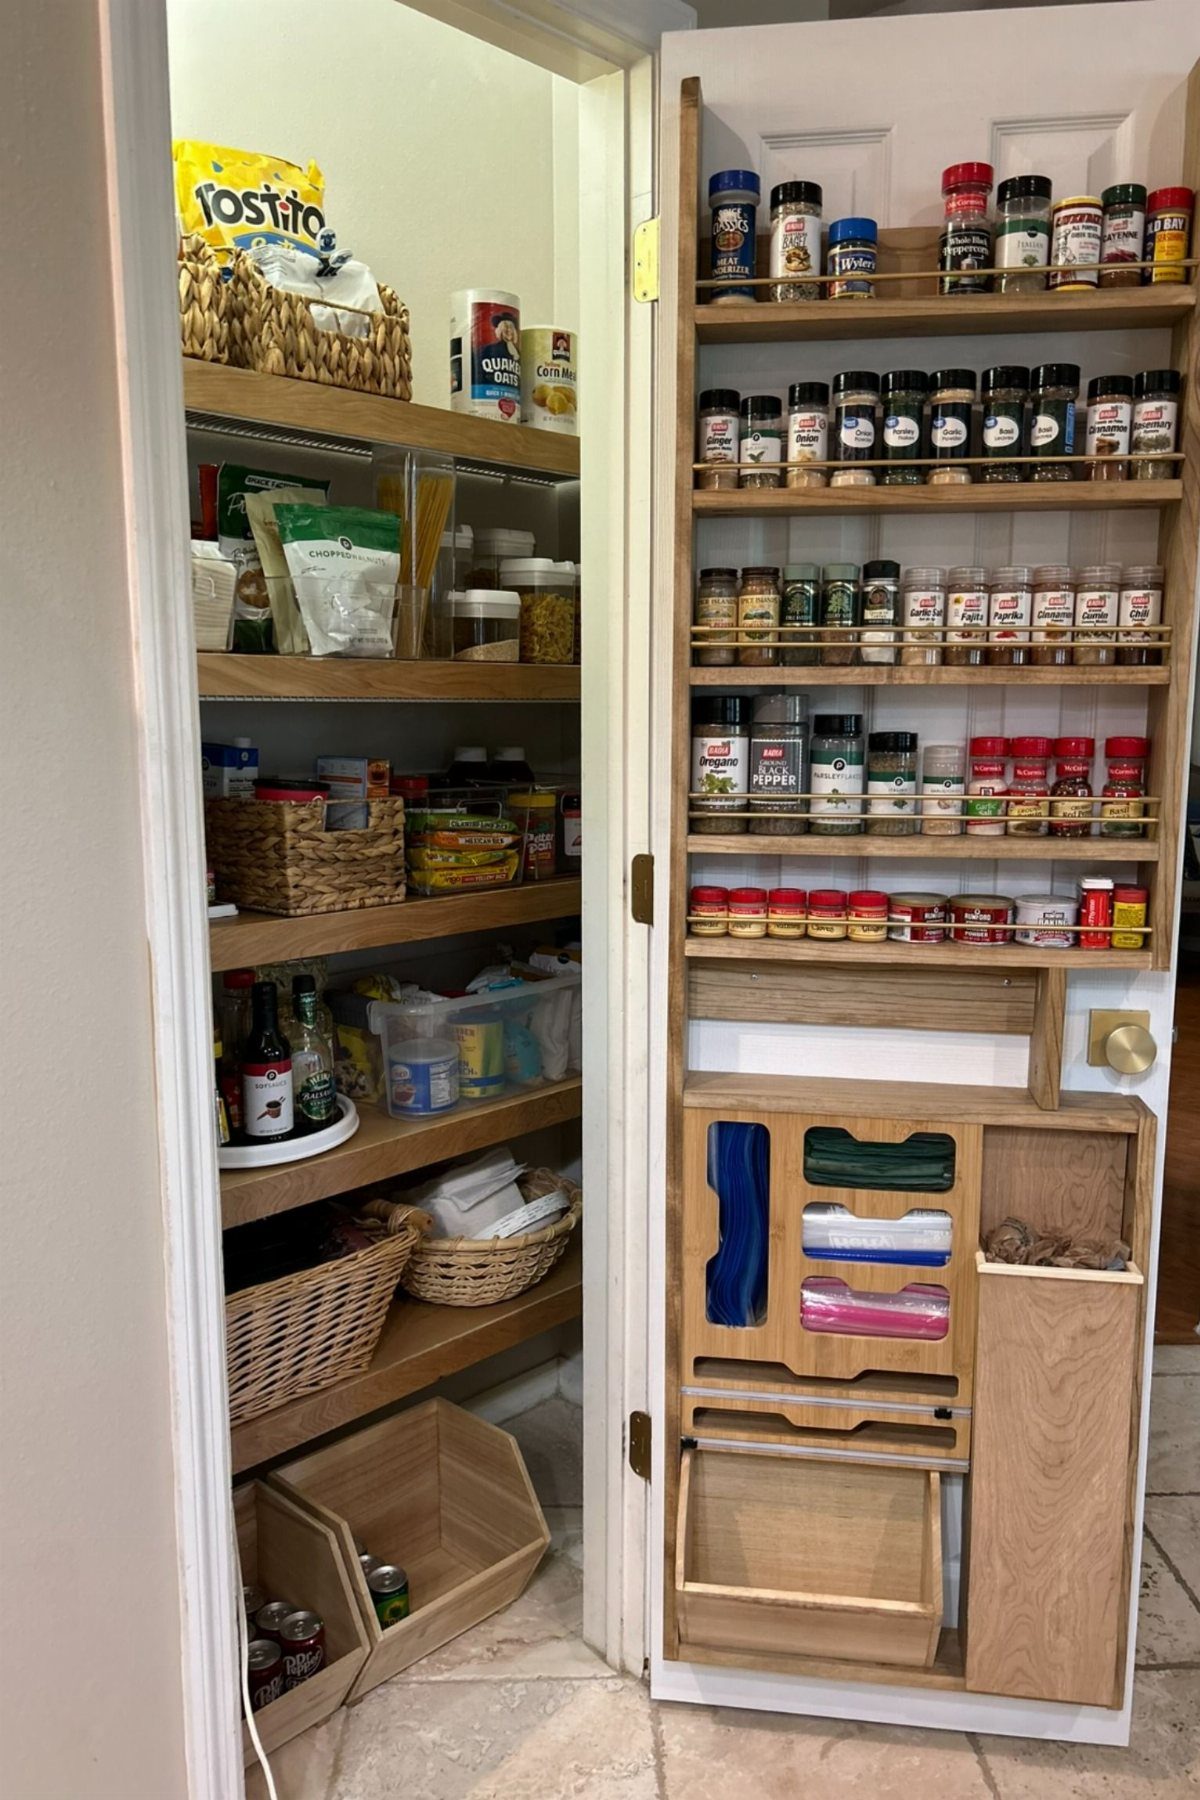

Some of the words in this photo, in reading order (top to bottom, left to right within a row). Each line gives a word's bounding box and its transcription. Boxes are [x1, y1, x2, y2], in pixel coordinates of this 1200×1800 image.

[195, 182, 326, 242] TOSTITO
[1163, 218, 1184, 230] BAY
[948, 237, 972, 245] Whole
[717, 257, 740, 265] MEAT
[840, 257, 876, 271] Wyler's
[482, 358, 520, 373] QUAKE
[537, 365, 560, 377] Corn
[561, 366, 577, 381] Mea
[494, 371, 519, 386] OATS
[1088, 425, 1128, 435] Cinnamon
[1133, 421, 1172, 431] Rosemary
[892, 429, 915, 437] Parsley
[706, 437, 732, 447] Ginger
[796, 434, 819, 443] Onion
[309, 551, 351, 560] CHOPPED
[910, 609, 931, 617] Garlic
[993, 612, 1024, 621] Paprika
[1037, 610, 1072, 619] Cinnamo
[1130, 609, 1149, 618] Chili
[763, 749, 783, 757] BADIA
[700, 756, 738, 768] Oregano
[758, 766, 789, 775] BLACK
[753, 774, 796, 785] PEPPER
[975, 803, 996, 811] Garlic
[1109, 807, 1129, 815] Basil
